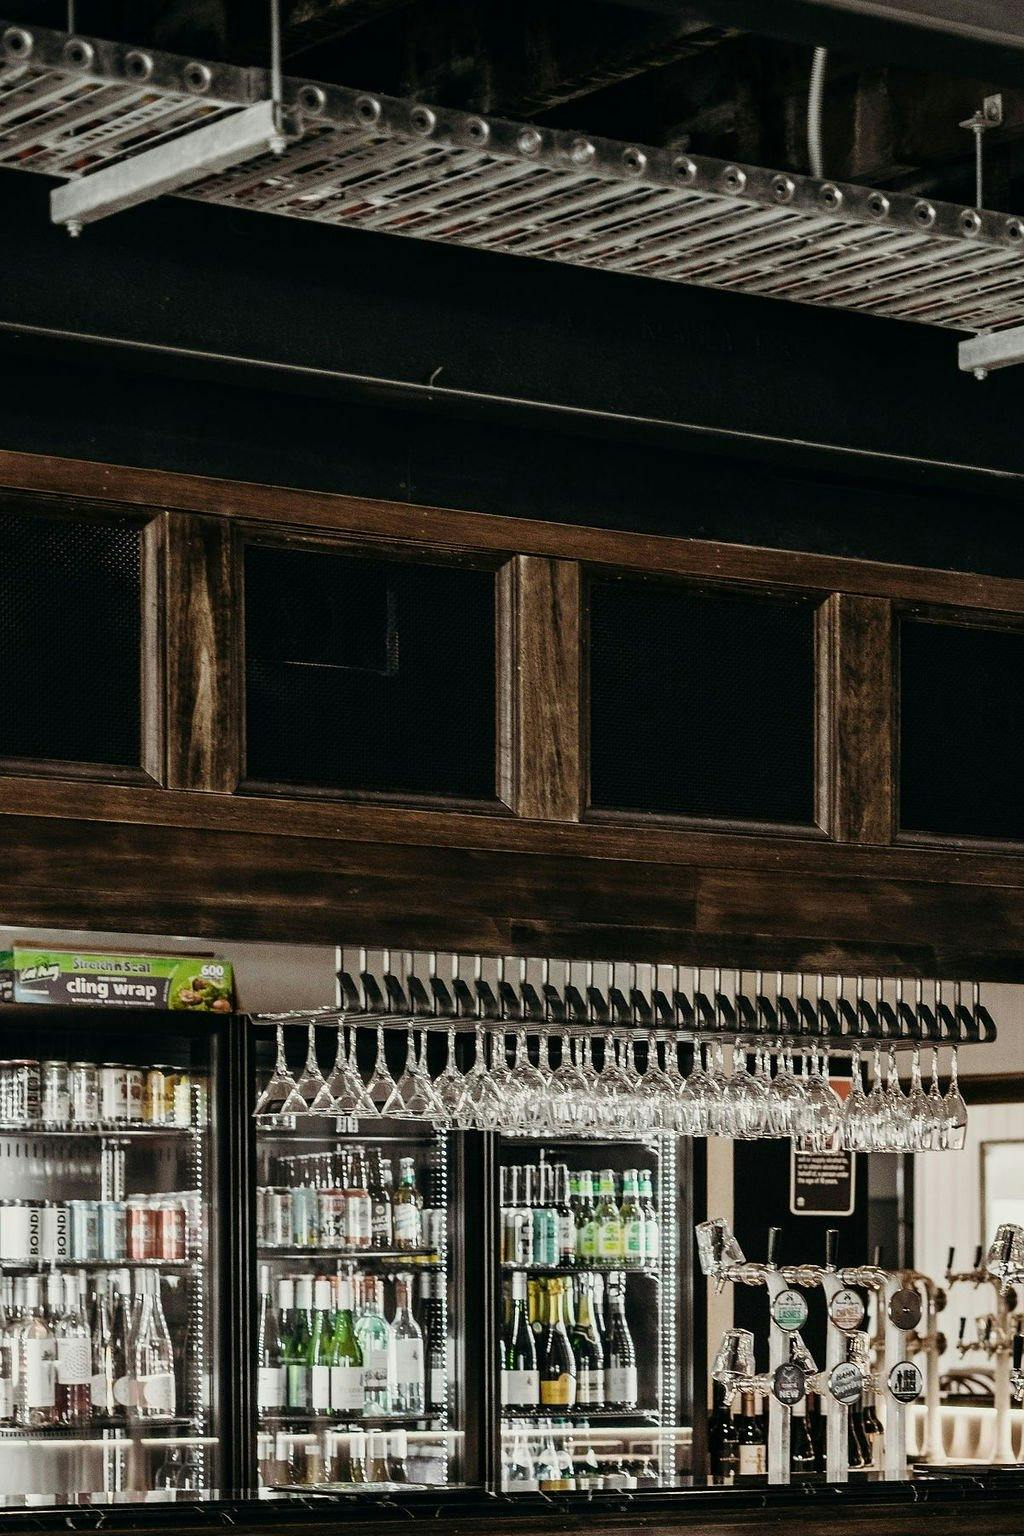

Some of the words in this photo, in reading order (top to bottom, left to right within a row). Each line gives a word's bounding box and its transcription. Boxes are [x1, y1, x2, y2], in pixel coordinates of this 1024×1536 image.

[201, 965, 224, 977] 600
[66, 977, 109, 998] cling
[113, 983, 158, 1000] wrap
[30, 1209, 39, 1255] BONDI
[57, 1210, 67, 1256] BONDI
